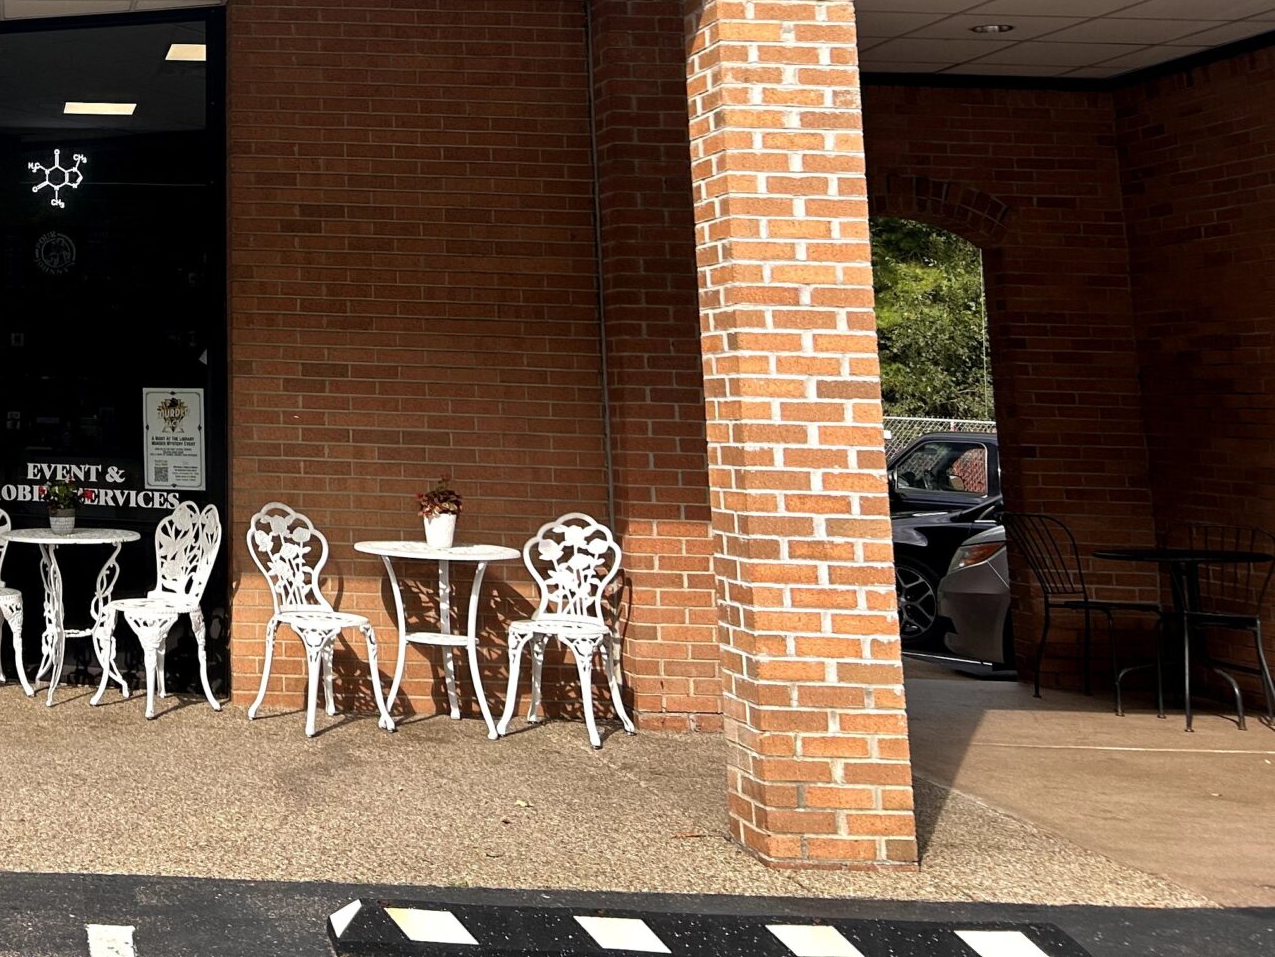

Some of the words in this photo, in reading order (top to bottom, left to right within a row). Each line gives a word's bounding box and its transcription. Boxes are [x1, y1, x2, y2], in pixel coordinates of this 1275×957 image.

[26, 462, 102, 482] EVENT
[105, 465, 126, 483] &
[77, 487, 181, 510] ERVICES
